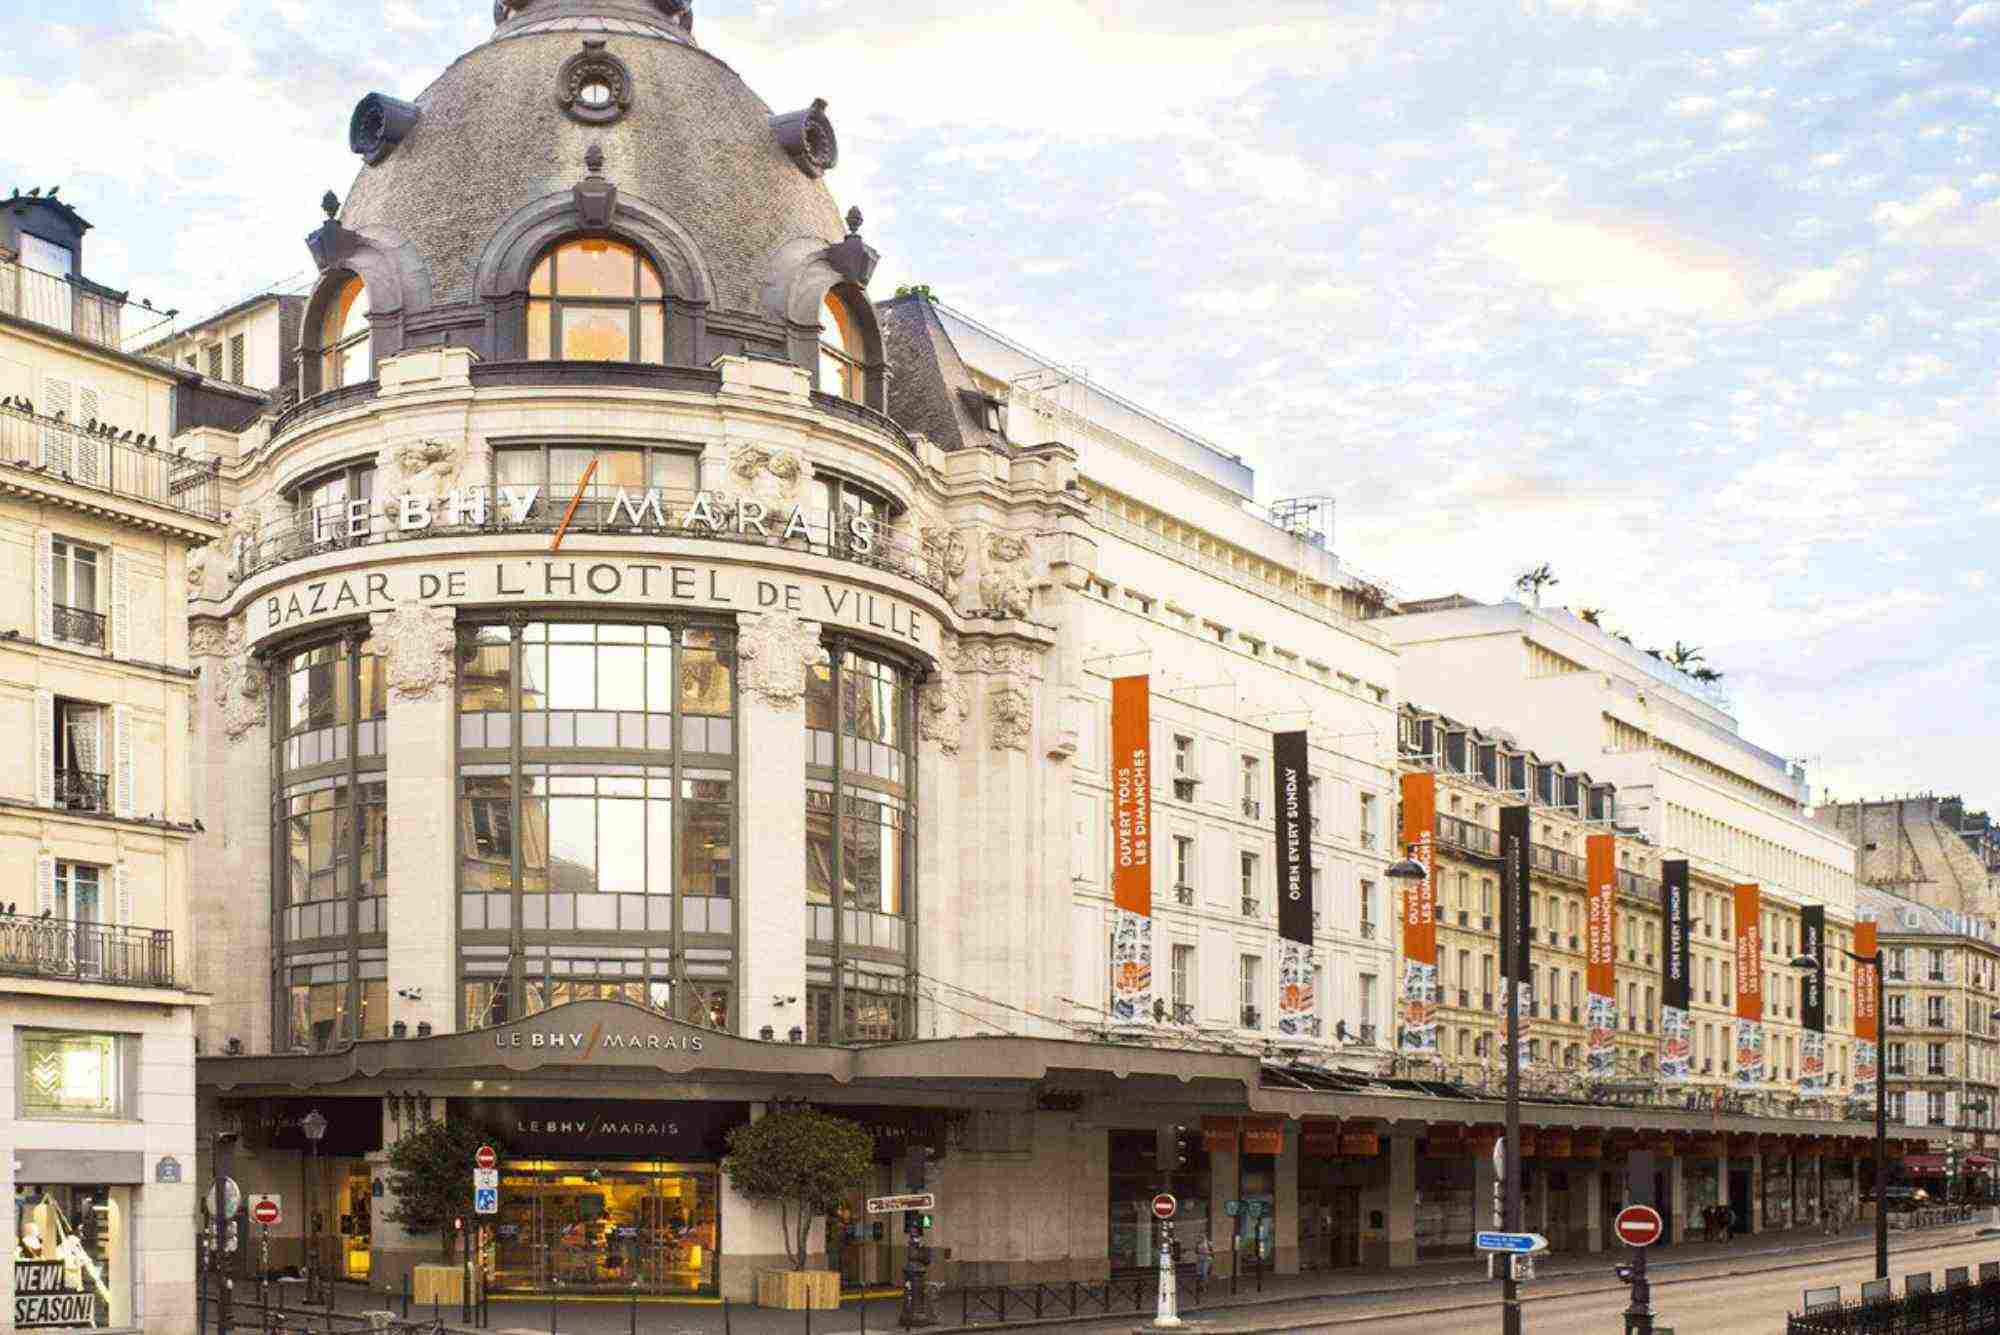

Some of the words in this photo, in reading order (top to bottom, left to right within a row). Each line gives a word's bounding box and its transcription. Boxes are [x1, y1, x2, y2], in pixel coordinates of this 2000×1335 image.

[313, 497, 370, 541] LE
[400, 486, 540, 533] BHV
[607, 486, 876, 554] MARAIS
[266, 572, 395, 629] BAZAR
[419, 569, 467, 600] DE
[496, 562, 731, 604] L'HOTEL
[757, 581, 802, 611] DE
[822, 583, 923, 644] VILLE
[1118, 768, 1131, 806] TOUS
[1133, 749, 1147, 836] DIMANCHES
[1285, 768, 1299, 818] SUNDAY
[1119, 810, 1132, 867] OUVERT
[1135, 840, 1147, 865] LES
[1288, 823, 1301, 862] EVERY
[1288, 865, 1302, 901] OPEN
[496, 1032, 521, 1046] LE
[531, 1033, 583, 1047] BHV
[602, 1034, 703, 1050] MARAIS
[517, 1120, 541, 1133] LE
[546, 1120, 586, 1133] BHV
[600, 1122, 680, 1135] MARAIS
[15, 1266, 63, 1291] NEW!
[15, 1296, 92, 1322] SEASON!
